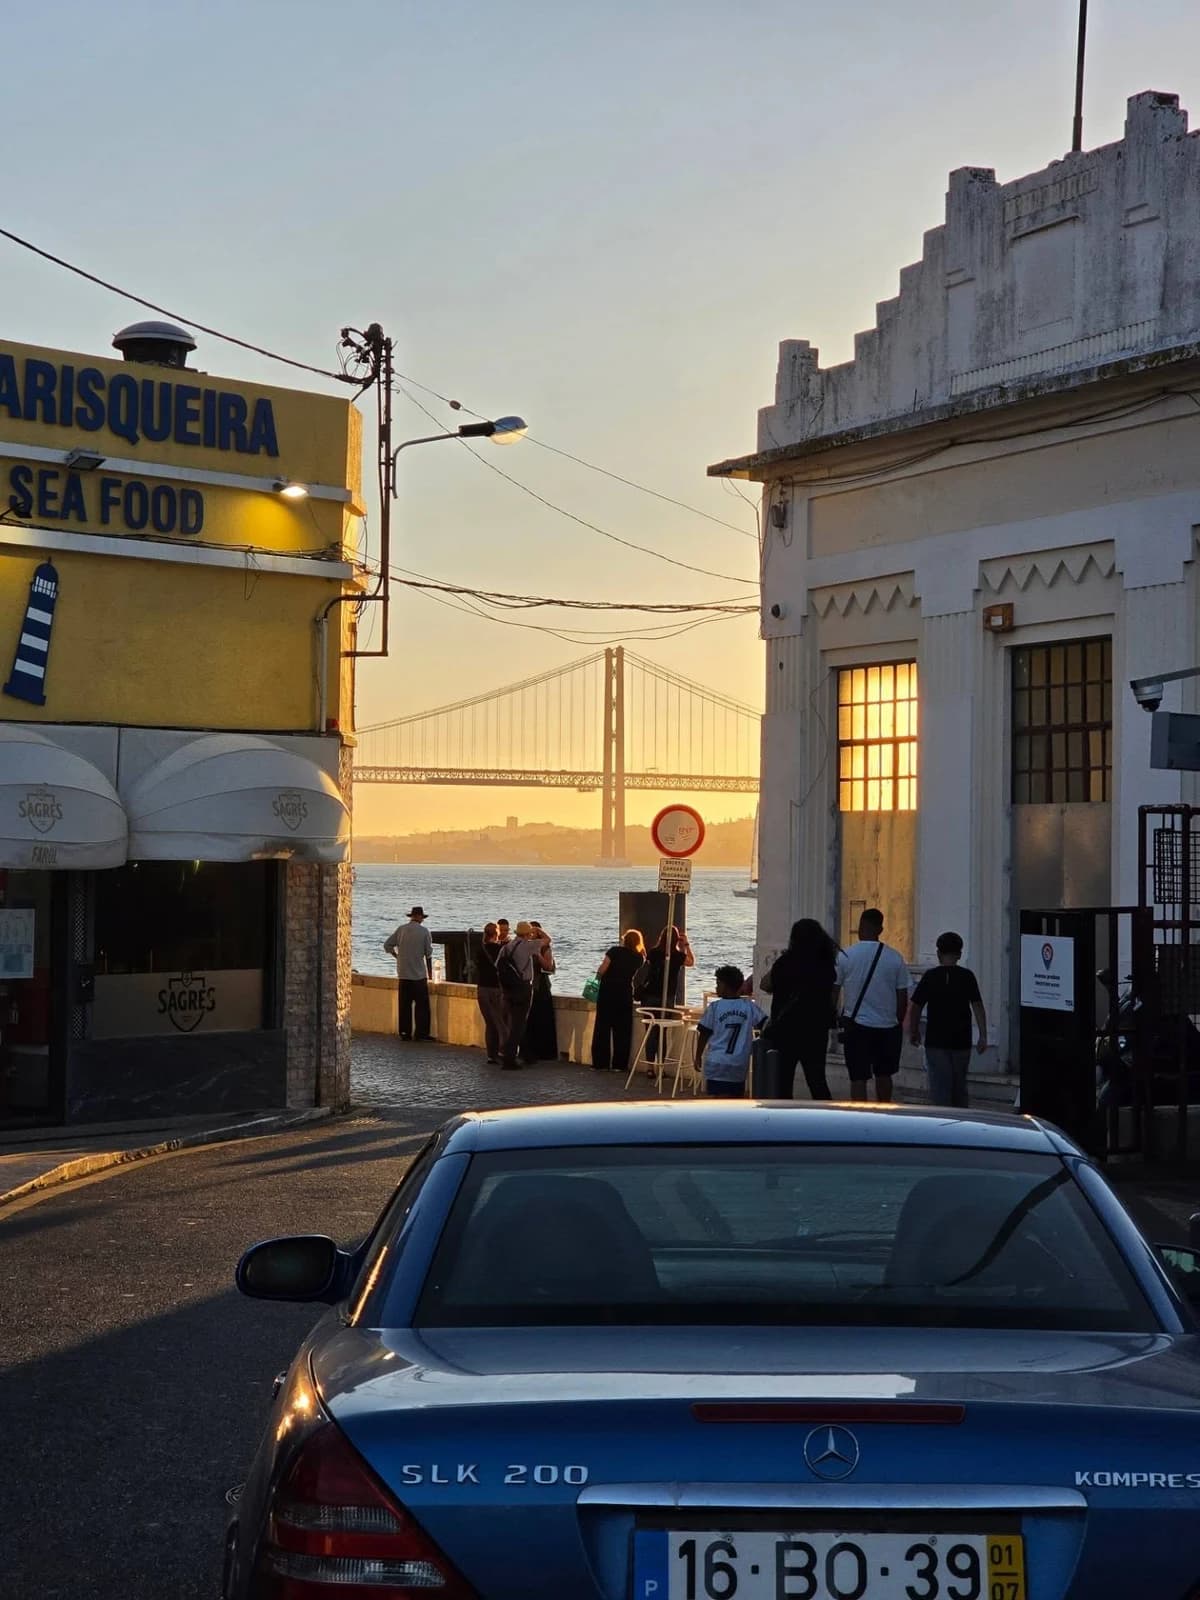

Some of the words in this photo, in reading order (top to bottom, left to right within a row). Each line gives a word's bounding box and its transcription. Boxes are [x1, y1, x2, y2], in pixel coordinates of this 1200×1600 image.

[0, 353, 279, 457] ARISQUEIRA
[9, 465, 87, 522] SEA
[101, 478, 204, 534] FOOD
[18, 800, 63, 820] SAGRES
[272, 801, 309, 818] SAGRES
[157, 987, 216, 1014] SAGRES
[725, 1023, 742, 1055] 7
[401, 1463, 481, 1485] SLK
[503, 1464, 589, 1485] 200
[1075, 1471, 1200, 1488] KOMPRES
[991, 1545, 1012, 1566] 01
[645, 1579, 658, 1596] P
[992, 1582, 1019, 1600] 07
